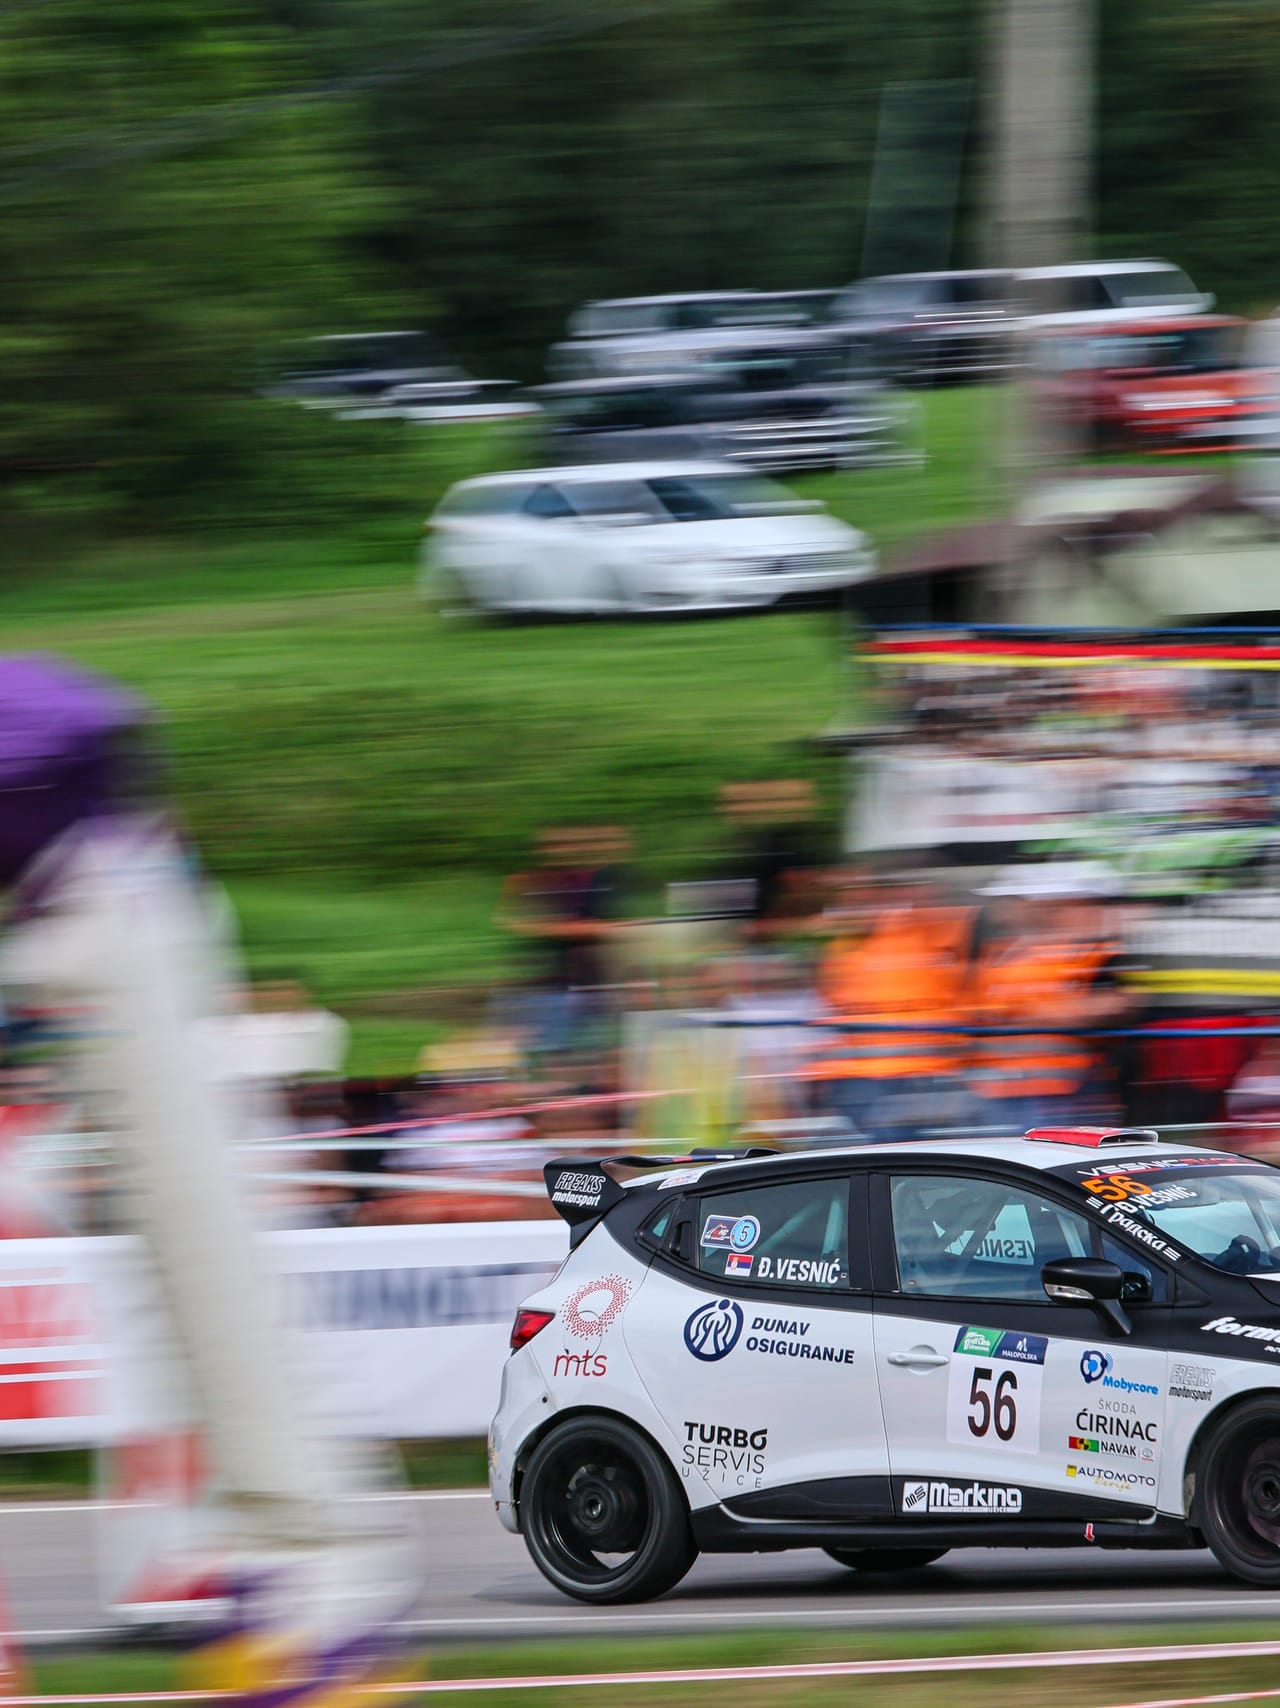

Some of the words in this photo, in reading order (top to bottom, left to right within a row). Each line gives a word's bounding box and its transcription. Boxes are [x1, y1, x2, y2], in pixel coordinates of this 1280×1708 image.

[554, 1171, 606, 1194] FREAKS
[1080, 1175, 1153, 1201] 56
[551, 1191, 601, 1207] motorsport
[738, 1226, 750, 1242] 5
[1100, 1203, 1169, 1251] Градска
[751, 1316, 810, 1337] DUNAV
[553, 1349, 608, 1377] mts
[745, 1337, 855, 1365] OSIGURANJE
[1102, 1376, 1159, 1395] Mobycore
[1169, 1364, 1216, 1389] FREAKS
[967, 1366, 1018, 1442] 56
[1168, 1385, 1213, 1402] motorsport
[1098, 1397, 1137, 1415] ŠKODA
[684, 1421, 768, 1451] TURBO
[1076, 1408, 1158, 1443] ĆIRINAC
[682, 1444, 765, 1475] SERVIS
[1101, 1441, 1137, 1457] NAVAK
[681, 1466, 763, 1489] UŽICE
[1077, 1466, 1156, 1487] AUTOMOTO
[928, 1482, 1023, 1513] Marking
